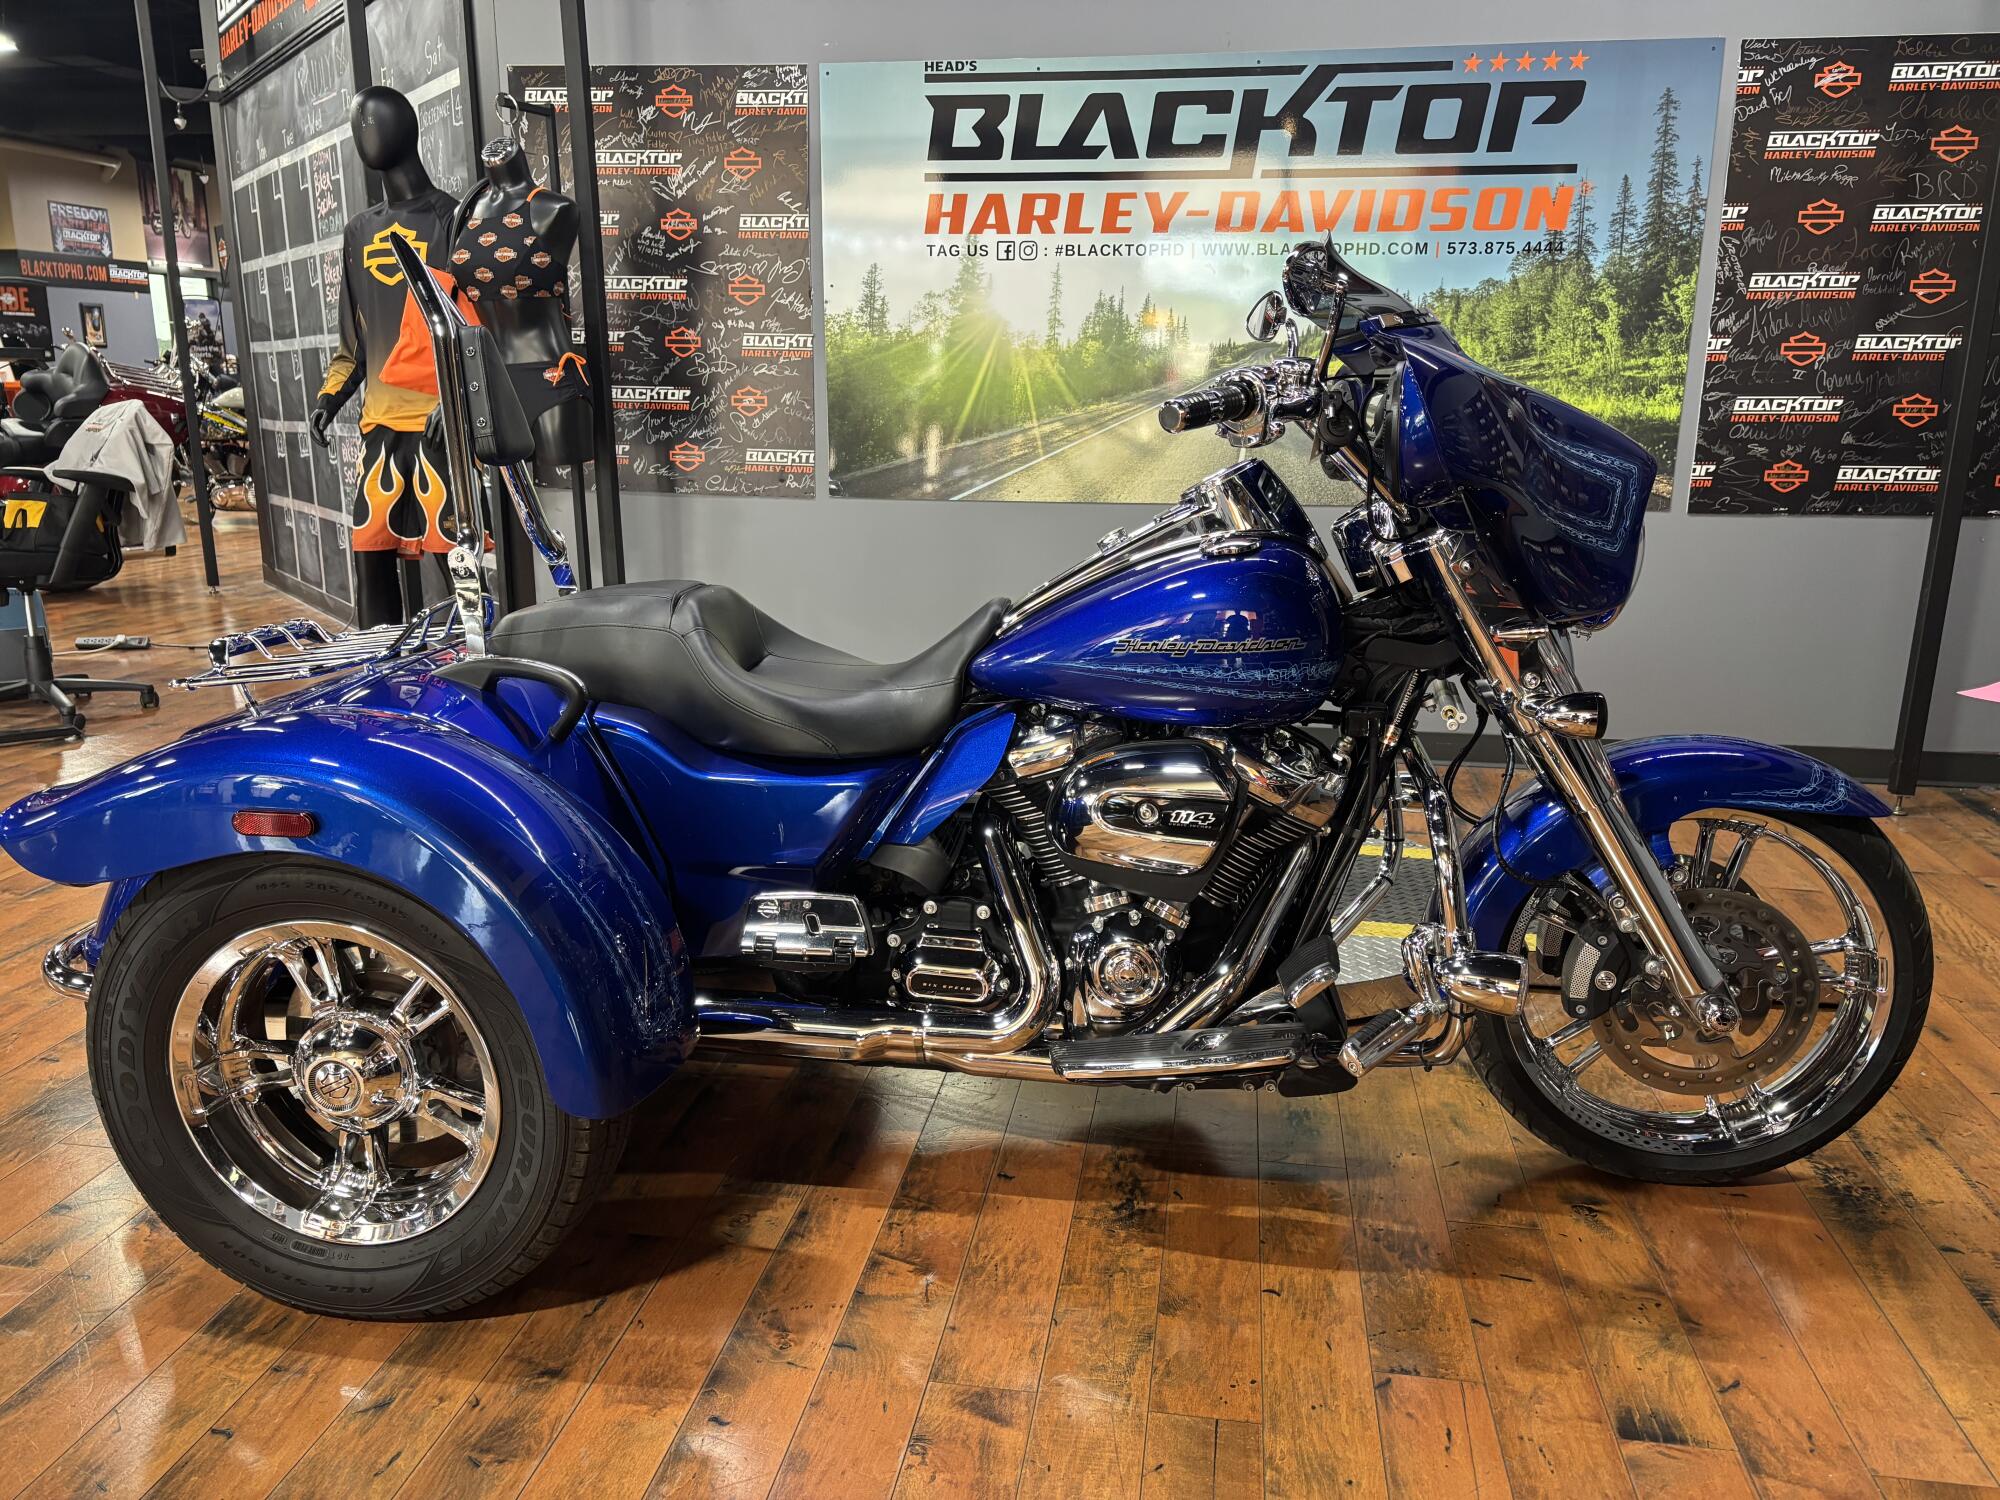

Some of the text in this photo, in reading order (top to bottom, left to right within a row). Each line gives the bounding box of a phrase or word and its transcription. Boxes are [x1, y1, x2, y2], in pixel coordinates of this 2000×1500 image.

[380, 67, 394, 87] Fri
[424, 35, 442, 74] Sat
[925, 60, 978, 72] HEAD'S
[455, 94, 462, 119] 4
[925, 72, 1587, 175] BLACKTOP
[1766, 131, 1880, 149] BLACKTOP
[595, 151, 683, 165] BLACKTOP
[1763, 149, 1876, 160] HARLEY-DAVIDSON
[49, 202, 108, 222] FREEDOM
[924, 187, 1575, 234] HARLEY-DAVIDSON
[1872, 205, 1983, 221] BLACKTOP
[1869, 223, 1981, 232] HARLEY-DAVIDSON
[926, 241, 1565, 257] TAG US #BLACKTOPHD WWW.BLAOPHD.COM 573.875.4444
[20, 258, 108, 282] BLACKTOPHD.COM
[1748, 274, 1861, 289] BLACKTOP
[606, 292, 687, 300] ARLEY-DAVIDSON
[1745, 291, 1856, 300] HARLEY-DAVIDSON
[1851, 353, 1945, 361] HARLEY-DAVIDS
[613, 402, 690, 411] ARLEY-DAVIDSON
[1733, 398, 1844, 413] BLACKTOP
[1730, 414, 1840, 423] HARLEY-DAVIDSON
[1111, 637, 1309, 657] Harley-Davidson
[1170, 810, 1216, 825] 114
